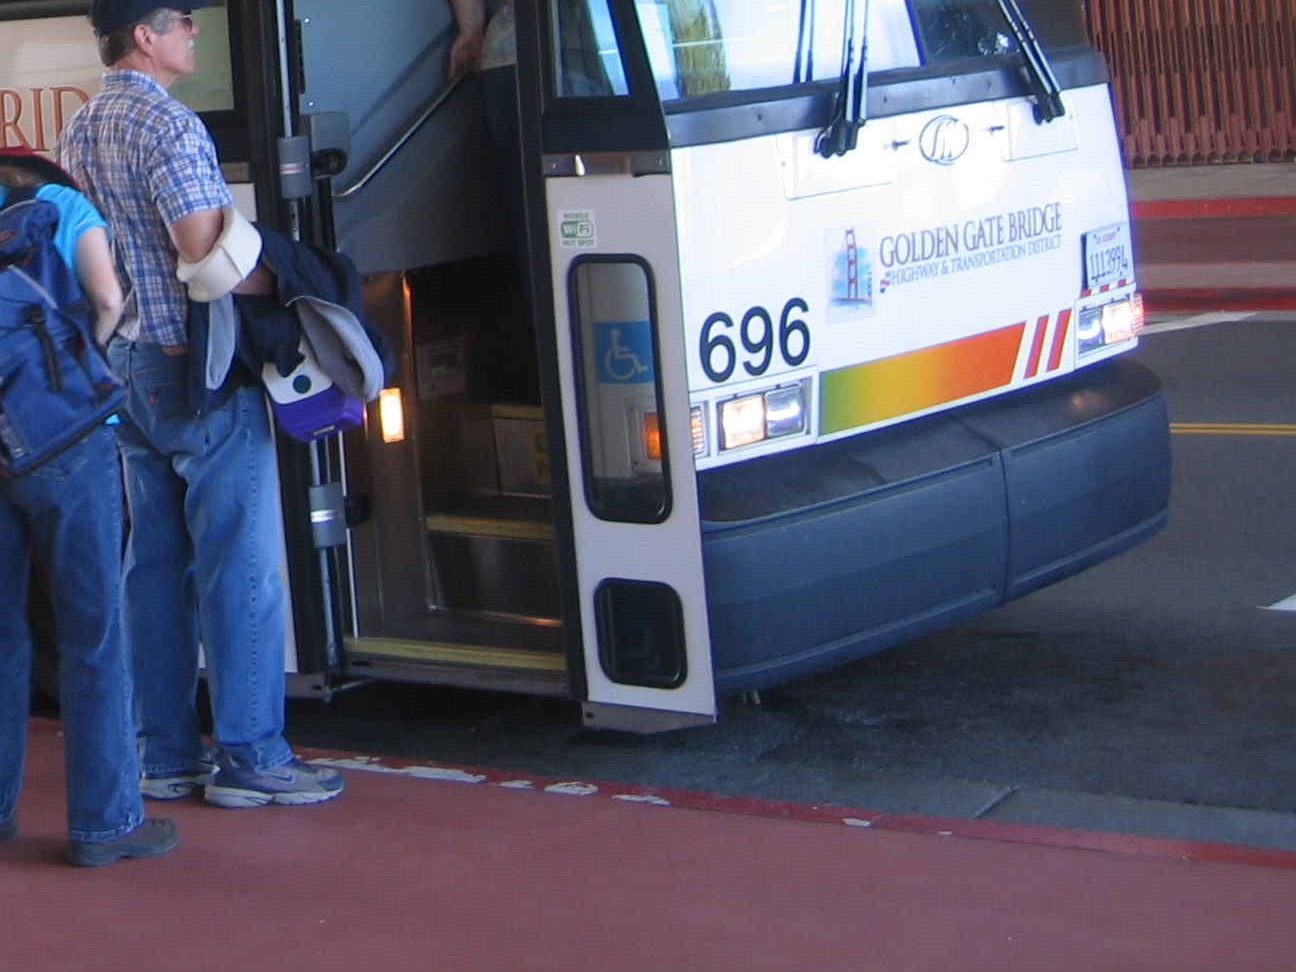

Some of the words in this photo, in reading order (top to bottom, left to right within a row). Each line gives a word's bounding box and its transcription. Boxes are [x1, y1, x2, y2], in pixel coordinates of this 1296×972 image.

[879, 224, 959, 268] GOLDEN
[963, 214, 1005, 251] GATE
[1008, 202, 1062, 242] BRIDGE
[891, 261, 940, 286] HIGHWAY
[941, 260, 950, 276] &
[951, 244, 1027, 273] TRANSPORTATION
[1027, 234, 1062, 256] DISTRICT
[699, 297, 810, 383] 696
